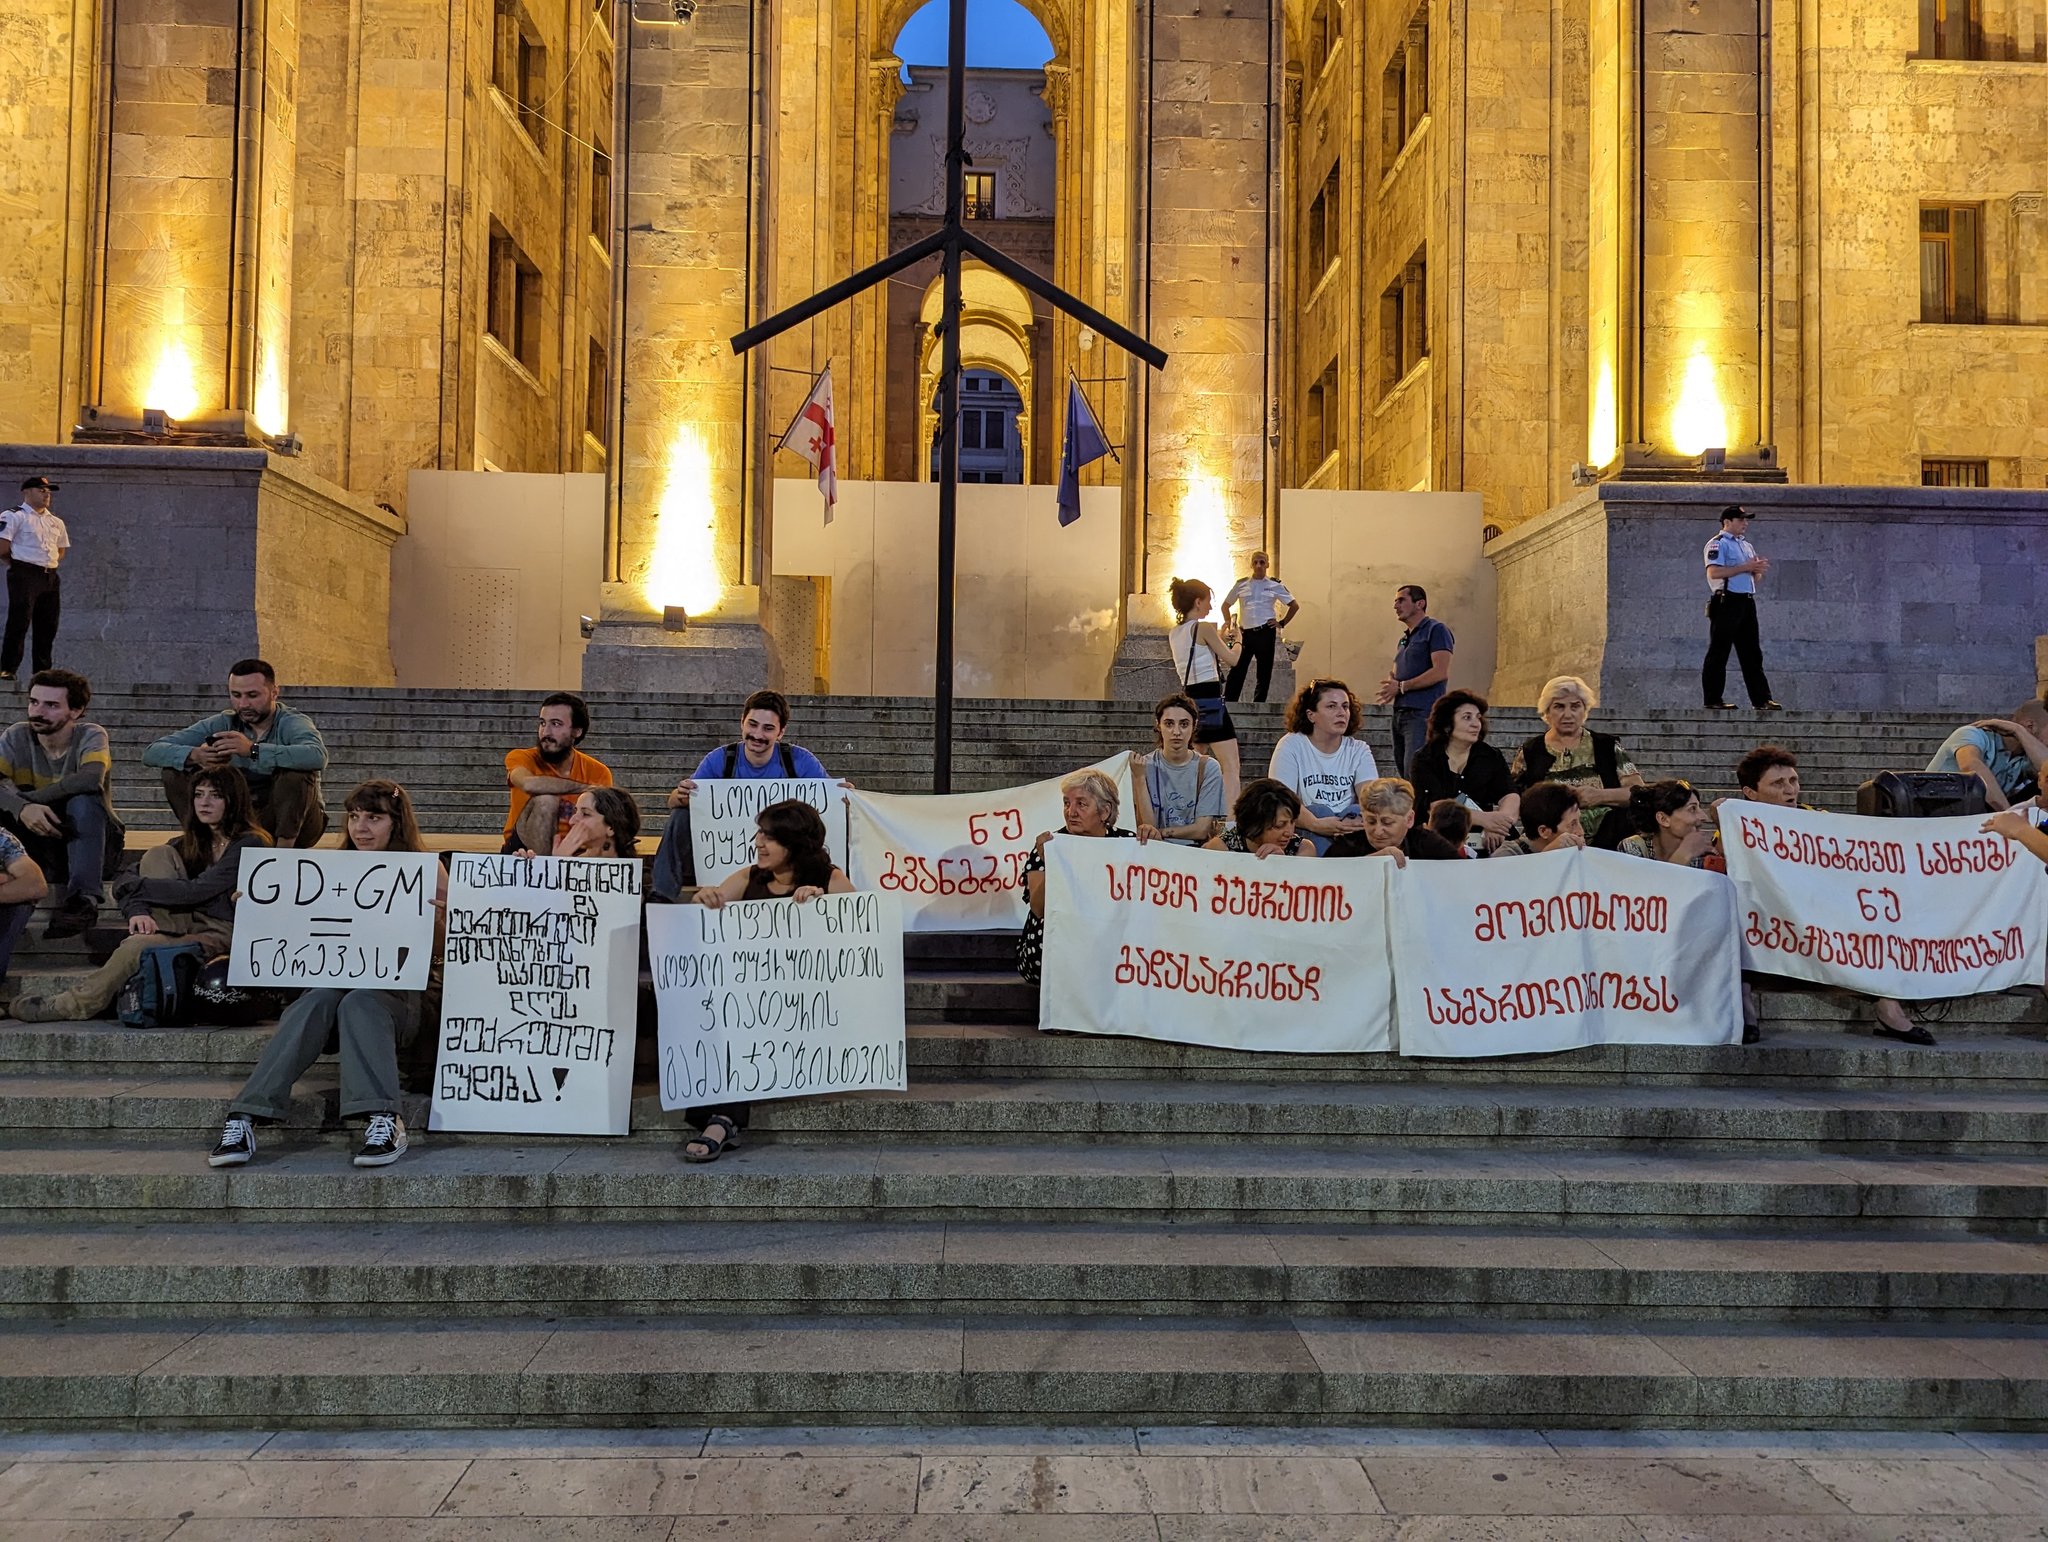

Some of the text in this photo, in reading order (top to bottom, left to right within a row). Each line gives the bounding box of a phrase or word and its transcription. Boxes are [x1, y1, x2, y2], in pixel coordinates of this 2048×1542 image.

[968, 808, 1023, 846] ნუ
[879, 851, 1030, 895] გვანგრევ
[1773, 825, 1906, 875] გვინგრევთ
[1915, 836, 2017, 876] სახლებს
[573, 895, 599, 917] და
[1105, 863, 1199, 913] სოფელ
[1857, 886, 1901, 923] ნუ
[700, 902, 802, 945] სოფელი
[1474, 891, 1669, 942] მოვითხოვთ
[250, 938, 410, 981] ნგრევას!
[1745, 911, 1884, 970] გვაქცევთ
[656, 945, 884, 991] სოფელი შუქრუთისთვის
[1114, 944, 1321, 1002] გადასარჩენად
[699, 990, 840, 1032] ჭიათურის
[1423, 971, 1680, 1026] სამართლიანობას
